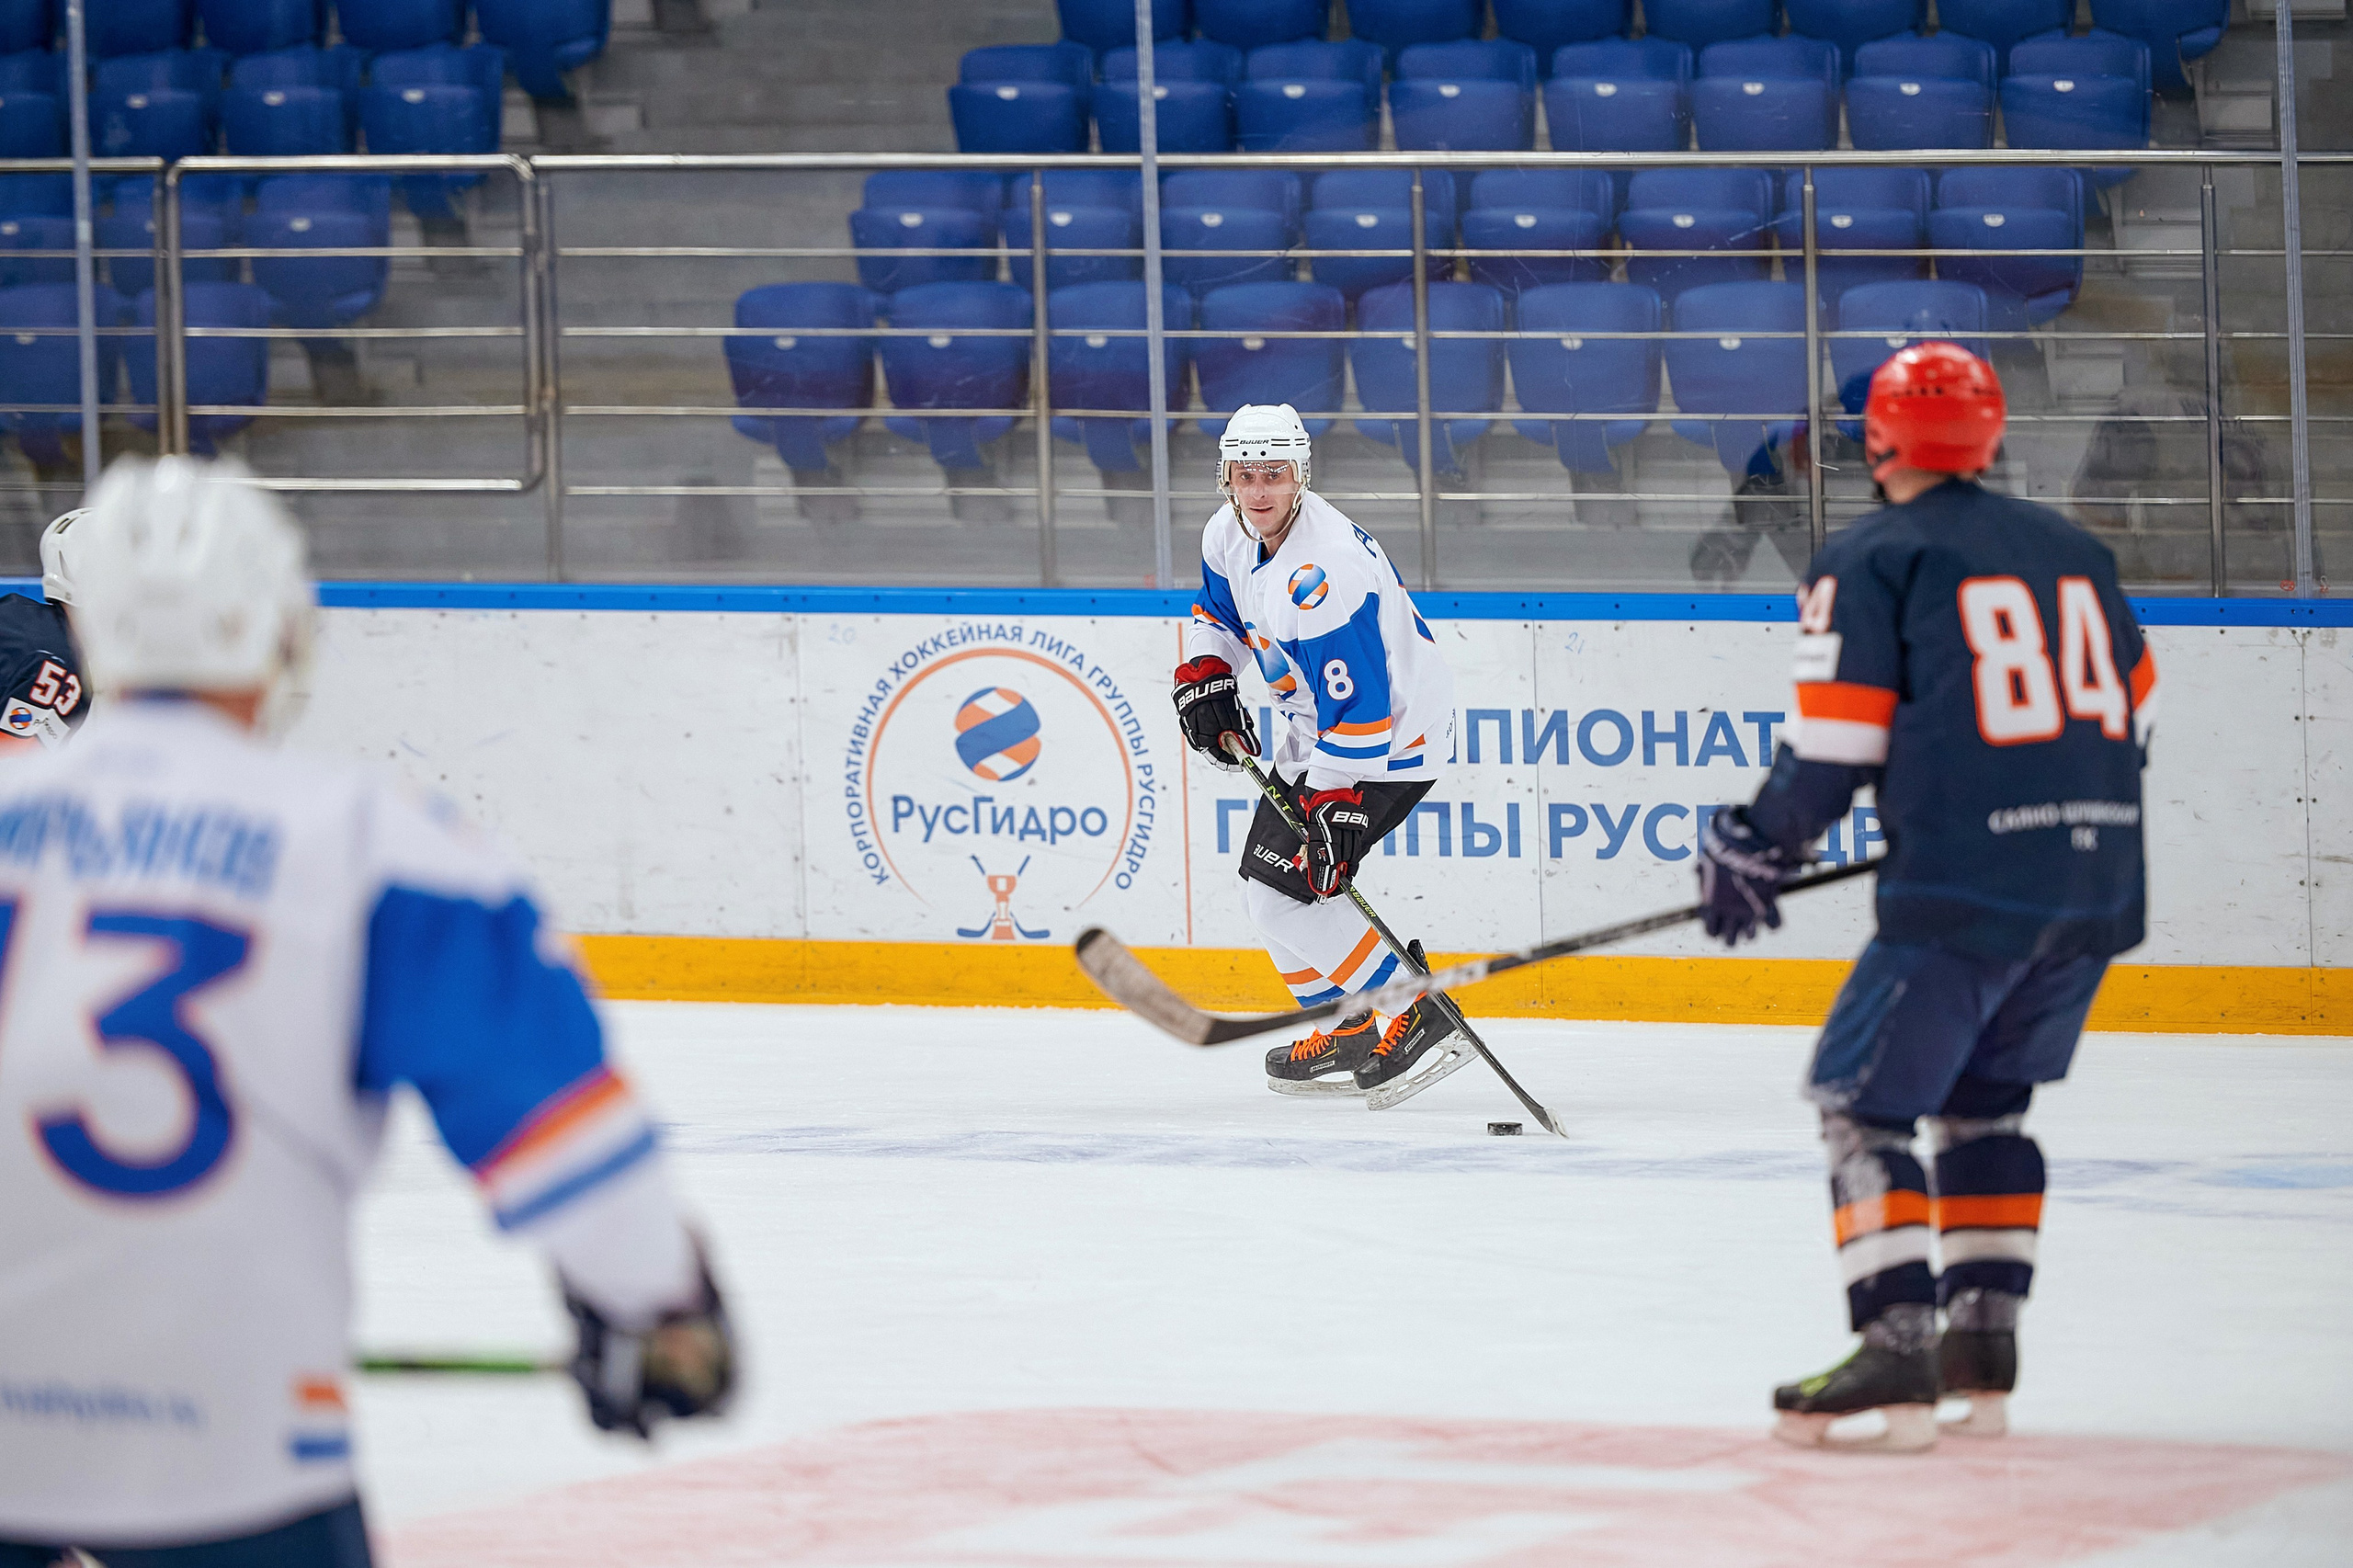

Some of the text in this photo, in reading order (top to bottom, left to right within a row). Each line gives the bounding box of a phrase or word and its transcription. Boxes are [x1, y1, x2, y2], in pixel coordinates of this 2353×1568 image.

[888, 622, 1023, 682] ХОККЕЙНАЯ
[1029, 631, 1085, 671] ЛИГА
[1324, 658, 1355, 700] 8
[1957, 575, 2129, 746] 84
[28, 660, 83, 716] 53
[1086, 666, 1150, 756] ГРУППЫ
[1447, 709, 1786, 767] ПИОНАТ
[845, 678, 892, 885] КОРПОРАТИВНАЯ
[892, 796, 1108, 845] РусГидро
[1115, 763, 1155, 890] РУСГИДРО
